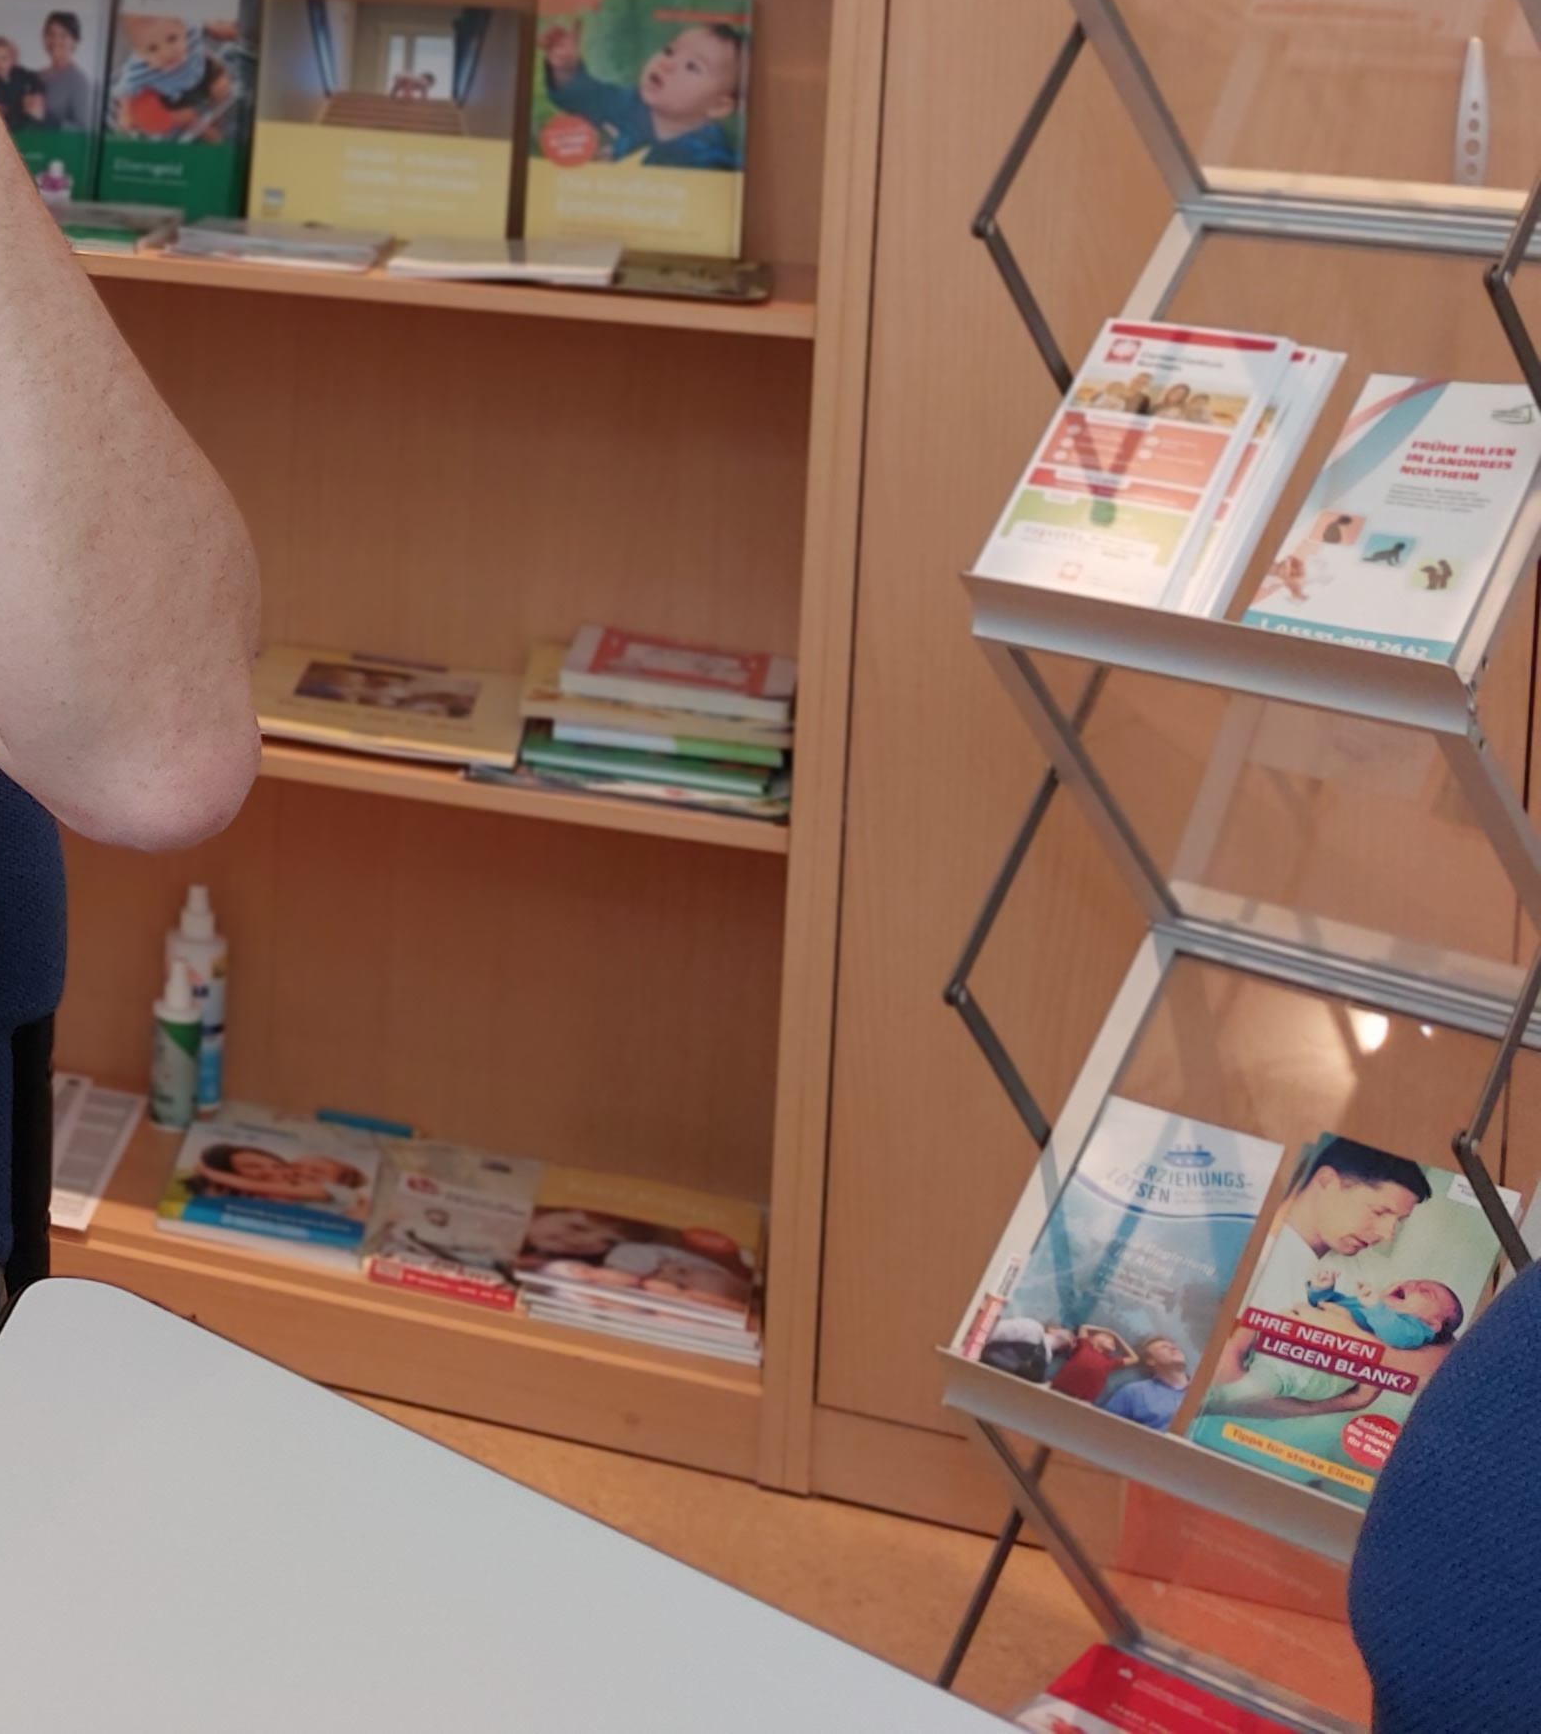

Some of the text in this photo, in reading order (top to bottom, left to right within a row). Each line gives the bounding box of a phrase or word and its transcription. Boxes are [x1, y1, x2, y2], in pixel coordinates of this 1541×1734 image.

[1405, 452, 1512, 470] IM LANDKREIS
[1412, 439, 1517, 457] FRÜHE HILFEN
[1400, 465, 1481, 481] NORTHEIM
[1133, 1163, 1254, 1189] ERZIEHUNGS-
[1248, 1311, 1377, 1359] IHRE NERVEN
[1262, 1336, 1413, 1389] LIEGEN BLANK?
[1232, 1428, 1367, 1487] Tipps für starke Eltern
